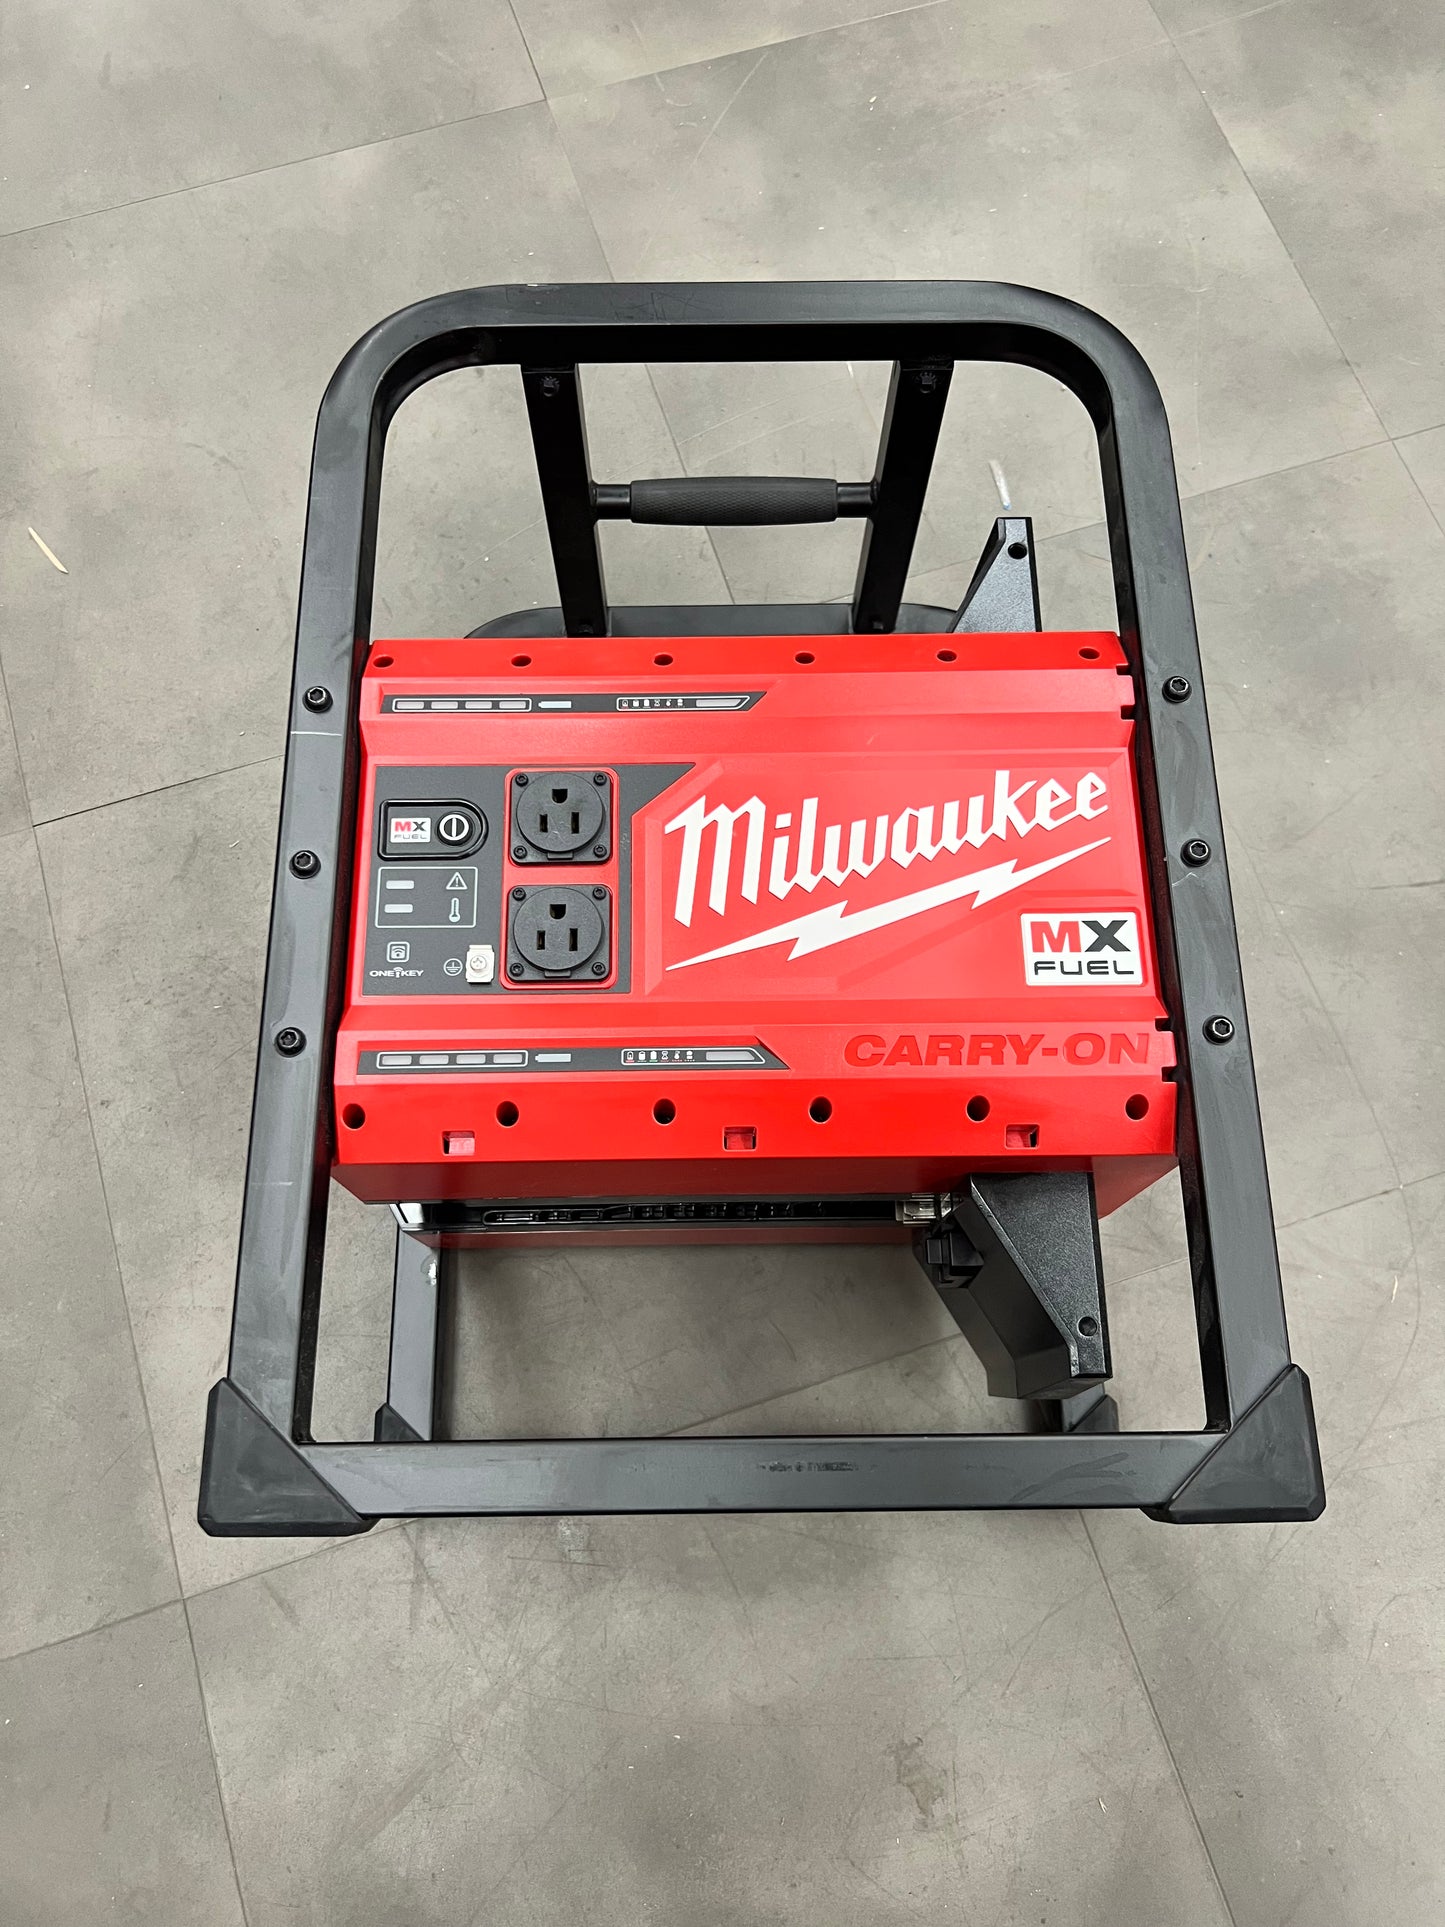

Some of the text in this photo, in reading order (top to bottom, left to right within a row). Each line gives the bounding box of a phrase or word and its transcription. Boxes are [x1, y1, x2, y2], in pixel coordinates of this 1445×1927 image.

[394, 821, 427, 832] MX
[665, 770, 1109, 927] Milwaukee
[1030, 919, 1131, 953] MX
[1034, 960, 1135, 976] FUEL
[844, 1033, 1150, 1068] CARRY-ON
